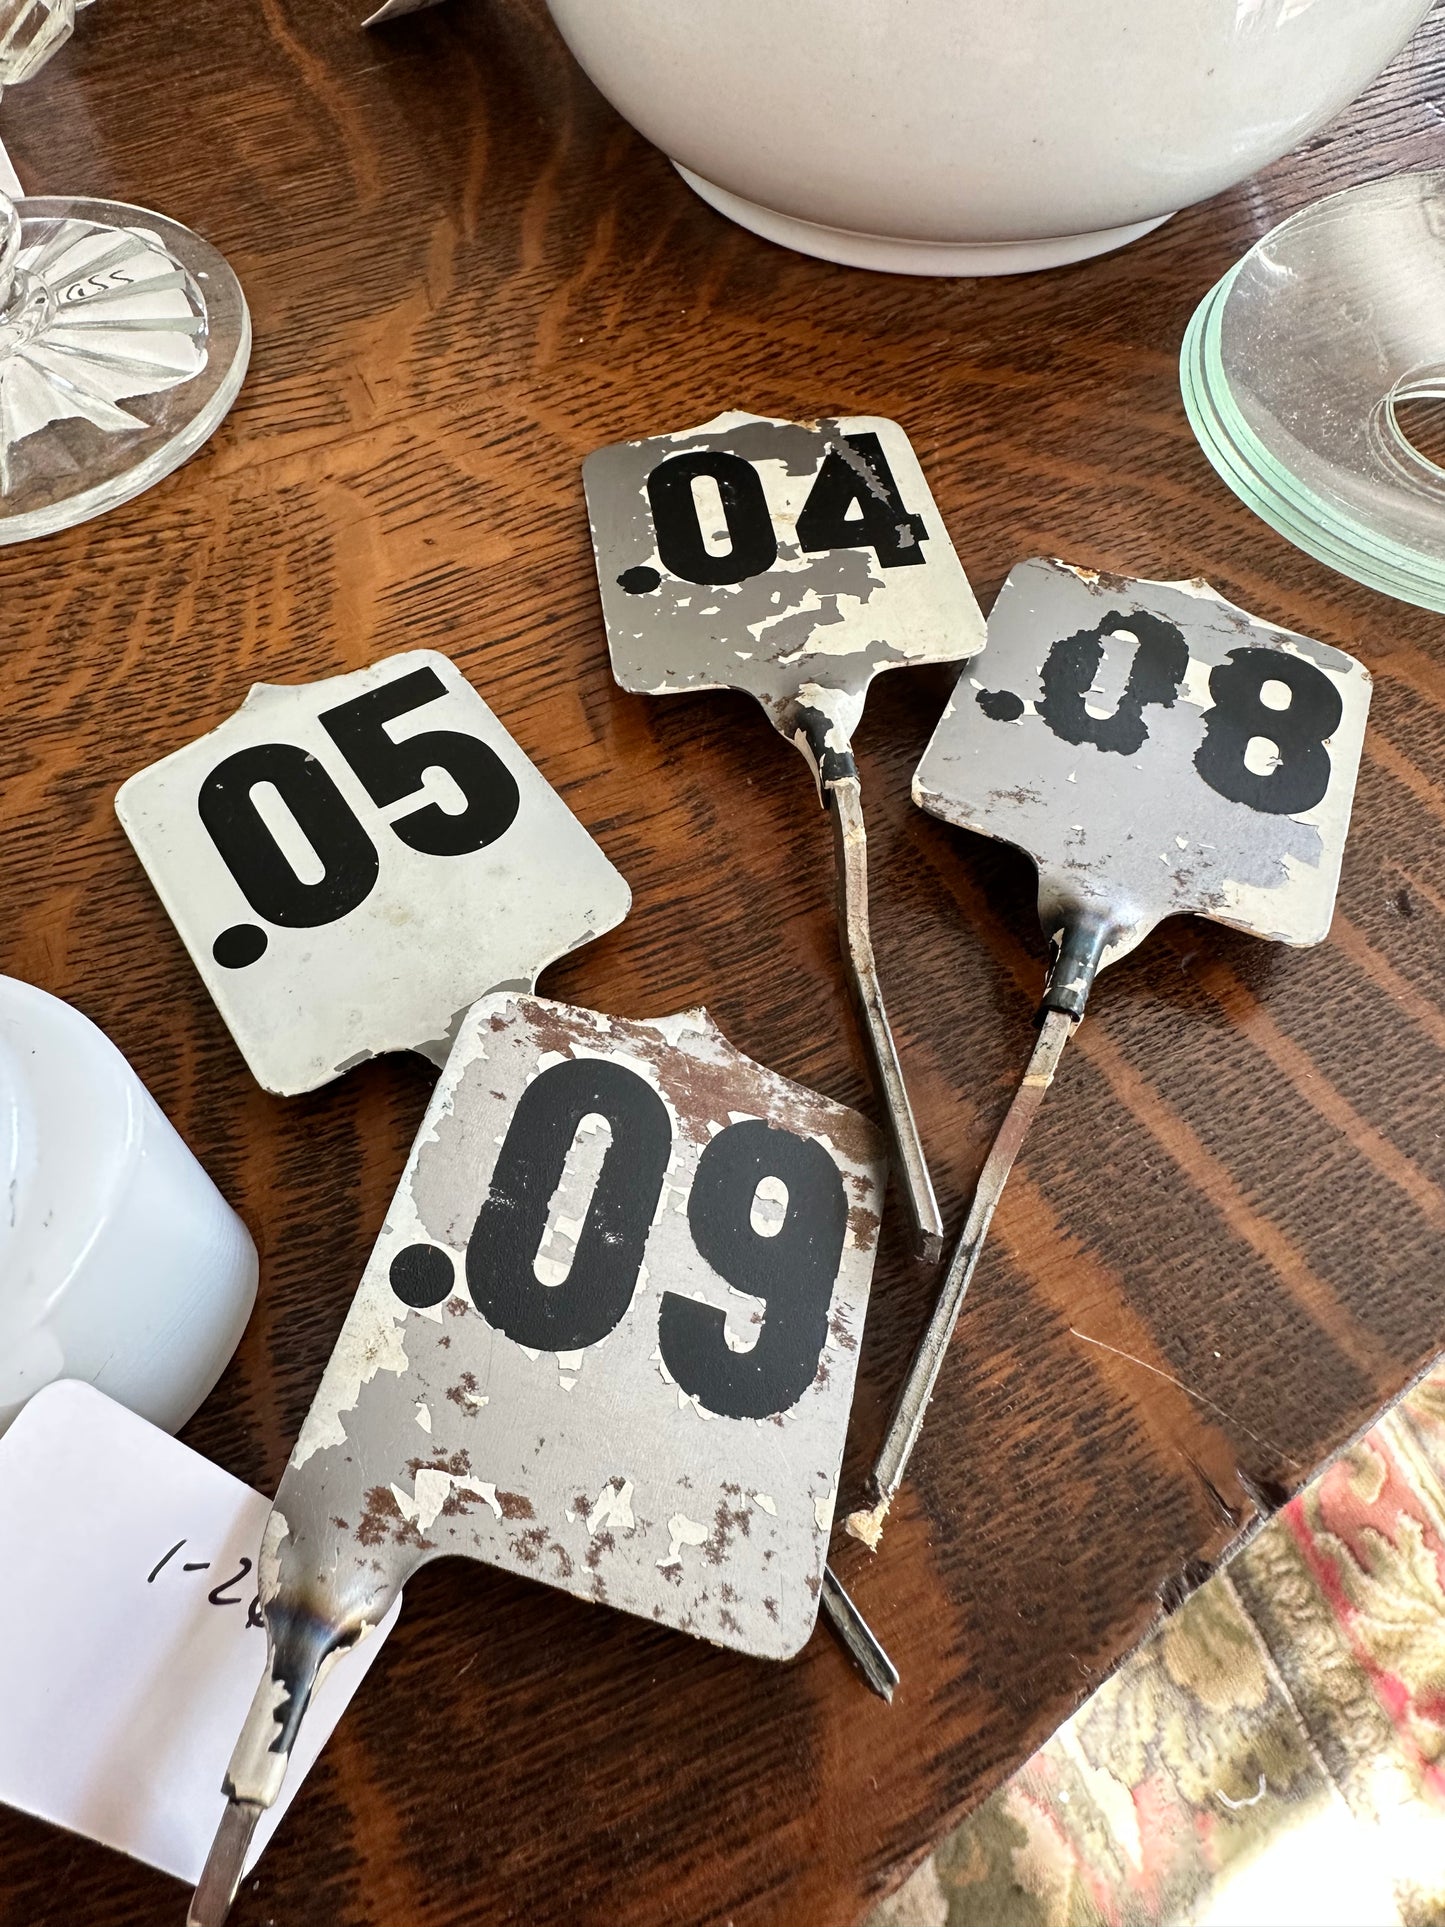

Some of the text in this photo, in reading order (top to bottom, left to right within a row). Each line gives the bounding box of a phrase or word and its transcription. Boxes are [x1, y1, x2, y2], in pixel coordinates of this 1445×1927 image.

[616, 432, 929, 594] .04
[198, 666, 520, 969] .05
[975, 609, 1343, 815] .08
[389, 1058, 849, 1421] .09
